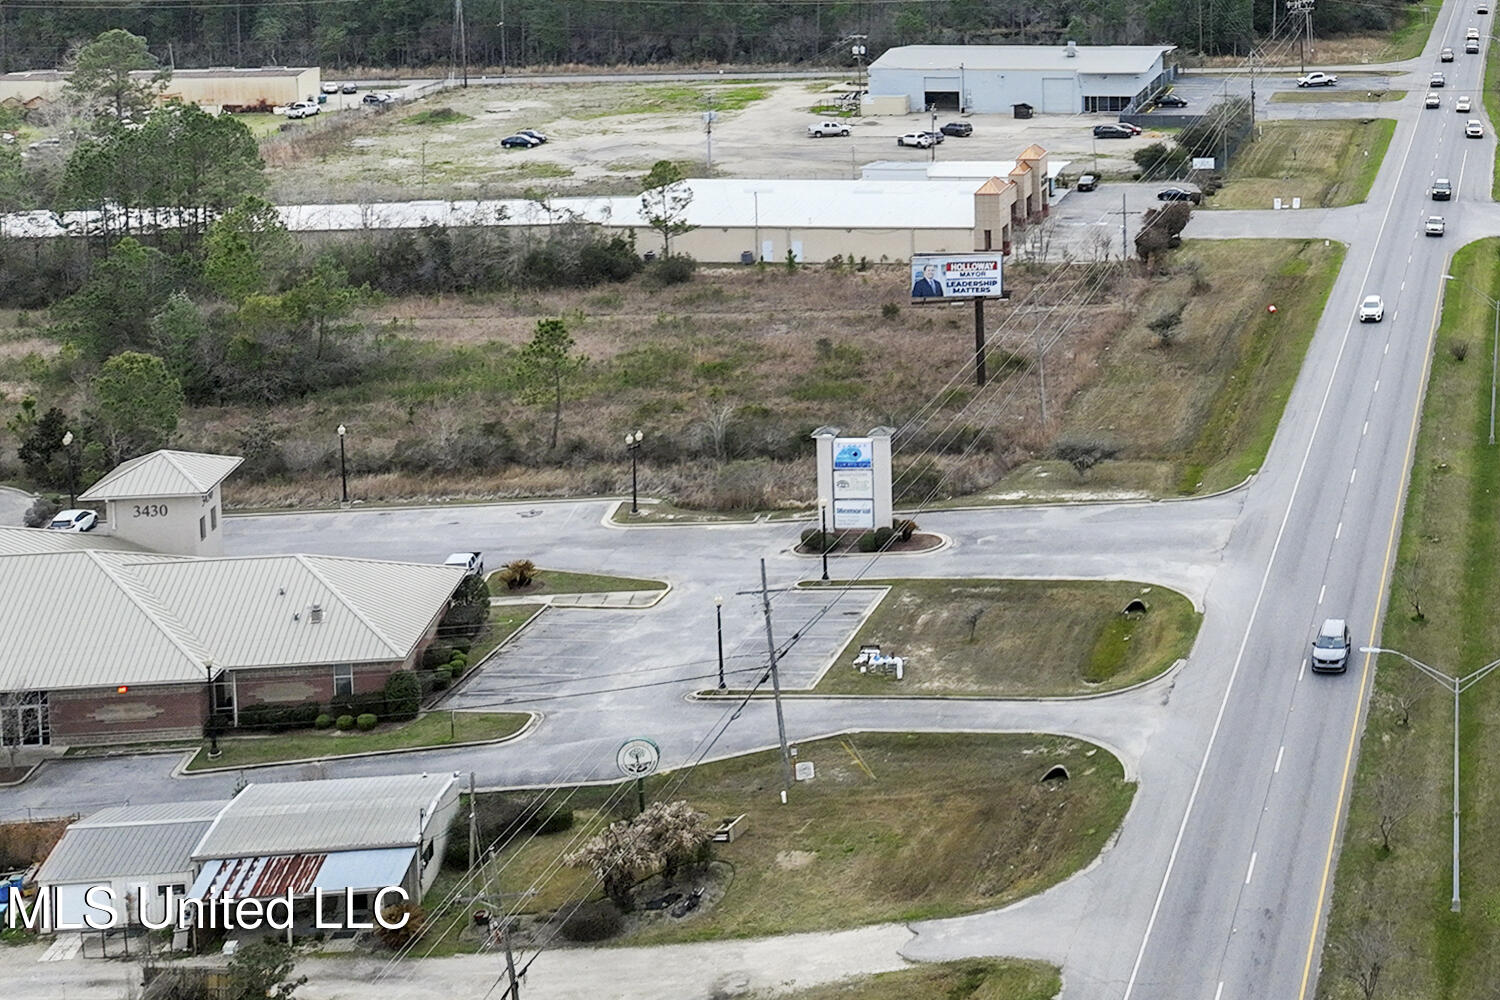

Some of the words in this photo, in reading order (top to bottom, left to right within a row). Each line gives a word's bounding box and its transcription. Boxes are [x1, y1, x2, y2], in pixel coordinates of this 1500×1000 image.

[950, 262, 995, 271] HOLLOWAY
[946, 280, 998, 288] LEADERSHIP
[133, 504, 168, 518] 3430
